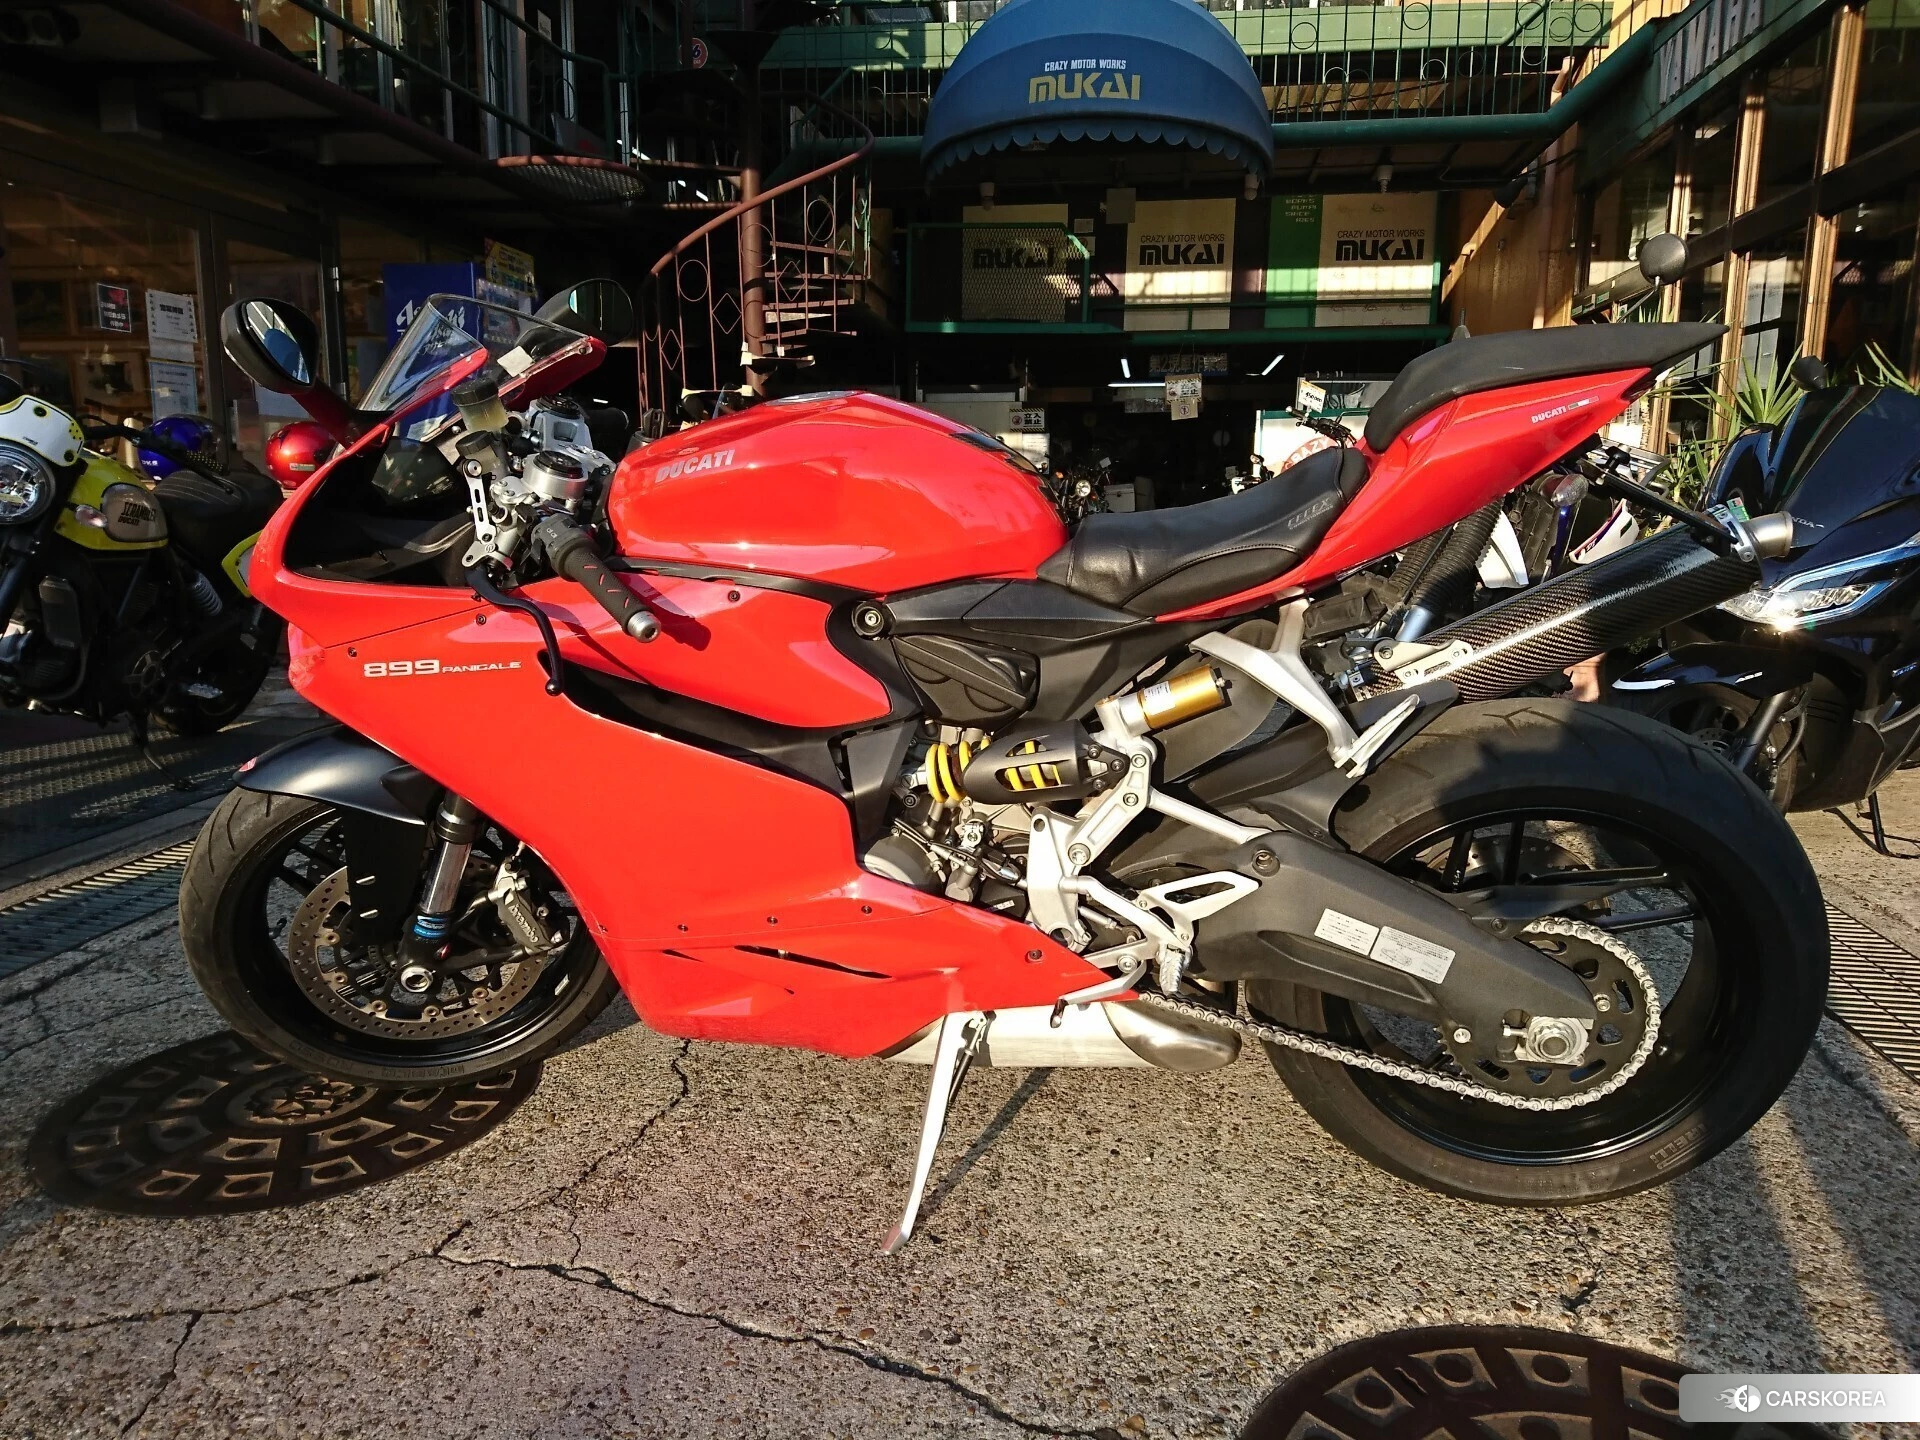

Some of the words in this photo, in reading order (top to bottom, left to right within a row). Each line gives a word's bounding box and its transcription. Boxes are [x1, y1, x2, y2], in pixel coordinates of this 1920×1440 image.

[1044, 60, 1068, 72] CRAZY
[1070, 59, 1096, 70] MOTOR
[1099, 59, 1126, 70] WORKS
[1028, 72, 1141, 104] MUKAI
[1140, 234, 1166, 243] CRAZY
[1167, 234, 1196, 243] MOTOR
[1198, 233, 1225, 242] WORKS
[1337, 230, 1363, 239] CRAZY
[1365, 229, 1395, 238] MOTOR
[1396, 229, 1425, 237] WORKS
[1139, 243, 1225, 266] MUKAI
[1335, 238, 1425, 261] MUKAI
[1531, 406, 1567, 424] DUCATI
[654, 449, 736, 484] DUCATI
[363, 659, 440, 678] 899
[441, 661, 522, 674] PANIGALE
[507, 903, 540, 943] brembo
[1649, 1120, 1710, 1164] IRELLI
